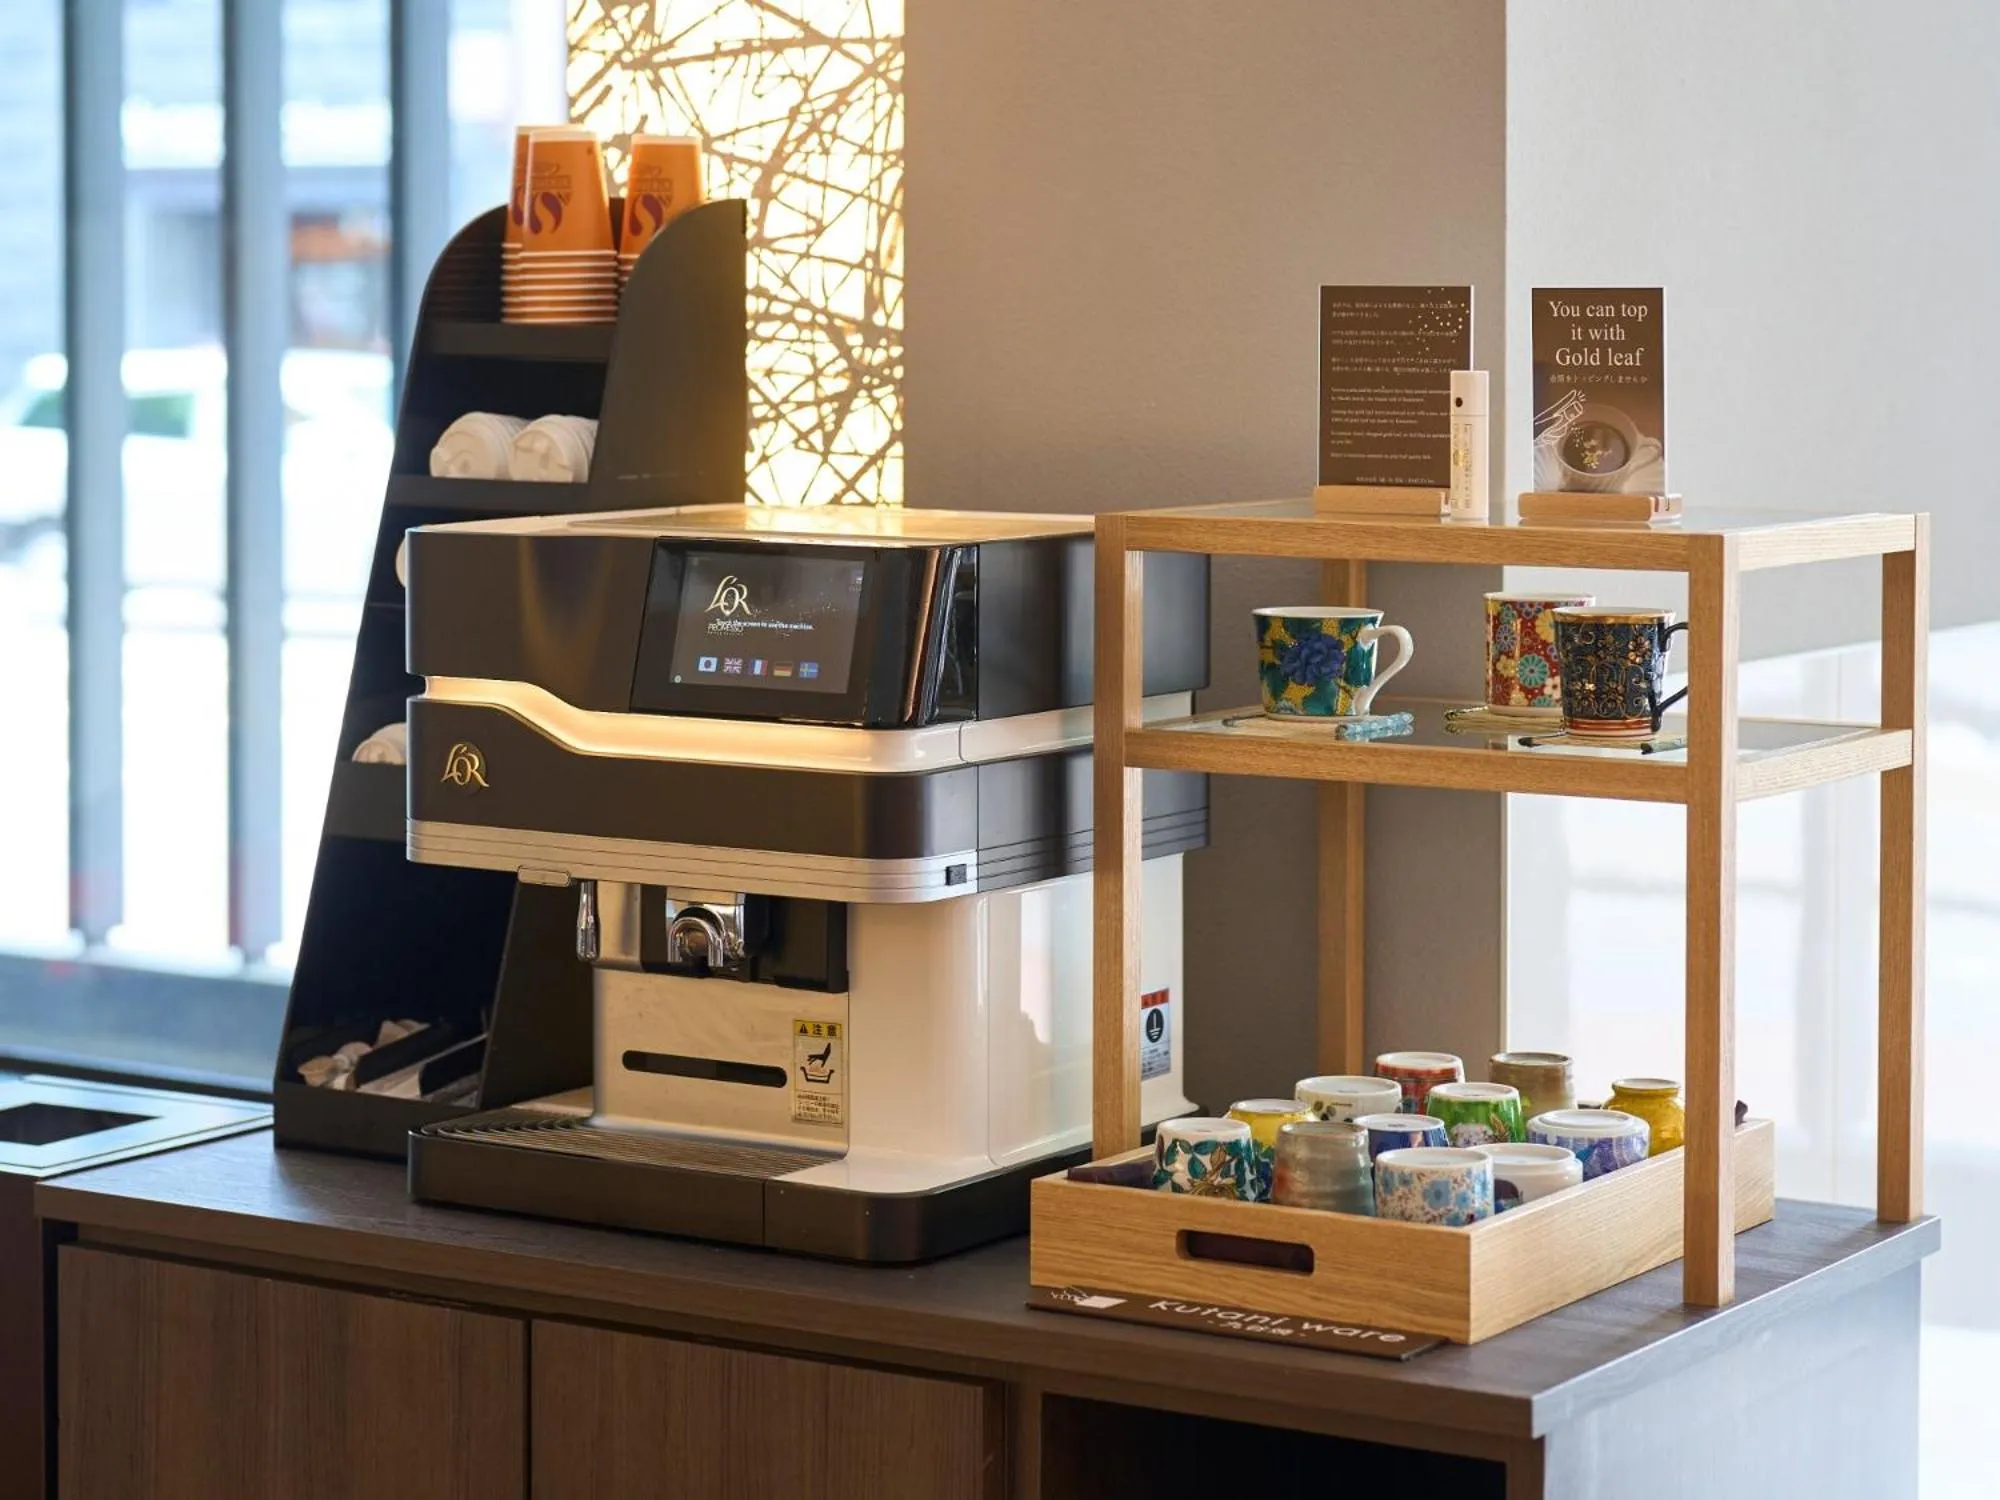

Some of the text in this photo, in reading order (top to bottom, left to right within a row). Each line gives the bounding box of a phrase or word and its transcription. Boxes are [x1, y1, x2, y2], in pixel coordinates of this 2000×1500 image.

[1549, 300, 1648, 321] You can top
[1571, 323, 1625, 340] it with
[1555, 347, 1645, 366] Gold leaf
[1149, 1300, 1406, 1343] Kutani ware
